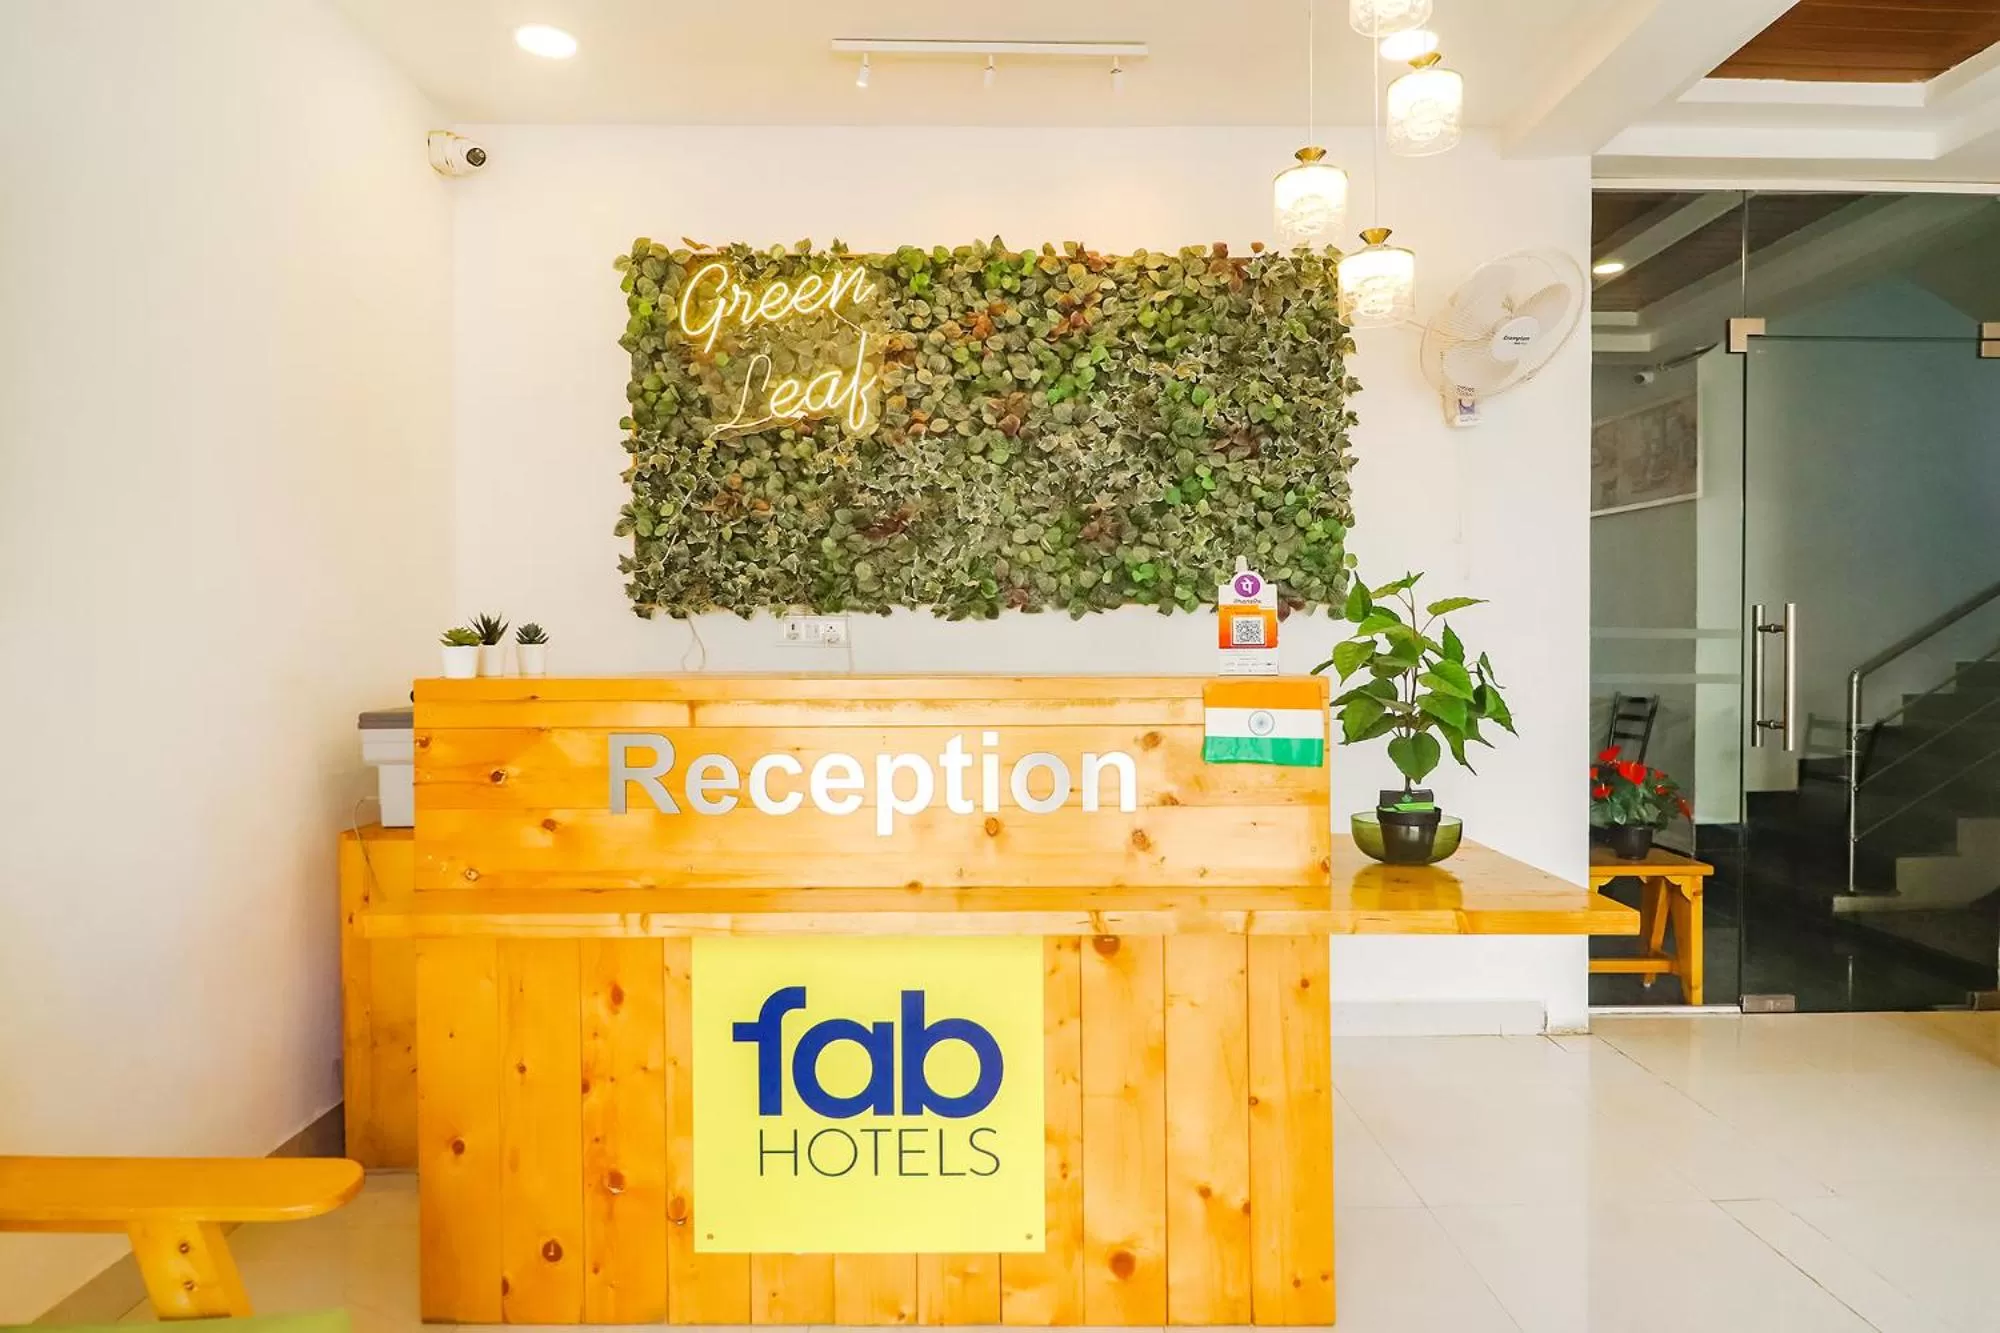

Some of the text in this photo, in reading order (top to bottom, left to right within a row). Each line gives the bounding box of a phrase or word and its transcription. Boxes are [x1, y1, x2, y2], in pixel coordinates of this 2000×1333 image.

[680, 263, 876, 353] Green
[714, 330, 877, 432] Leaf
[608, 731, 1137, 836] Reception
[732, 986, 1004, 1119] fab
[759, 1127, 1001, 1177] HOTELS
